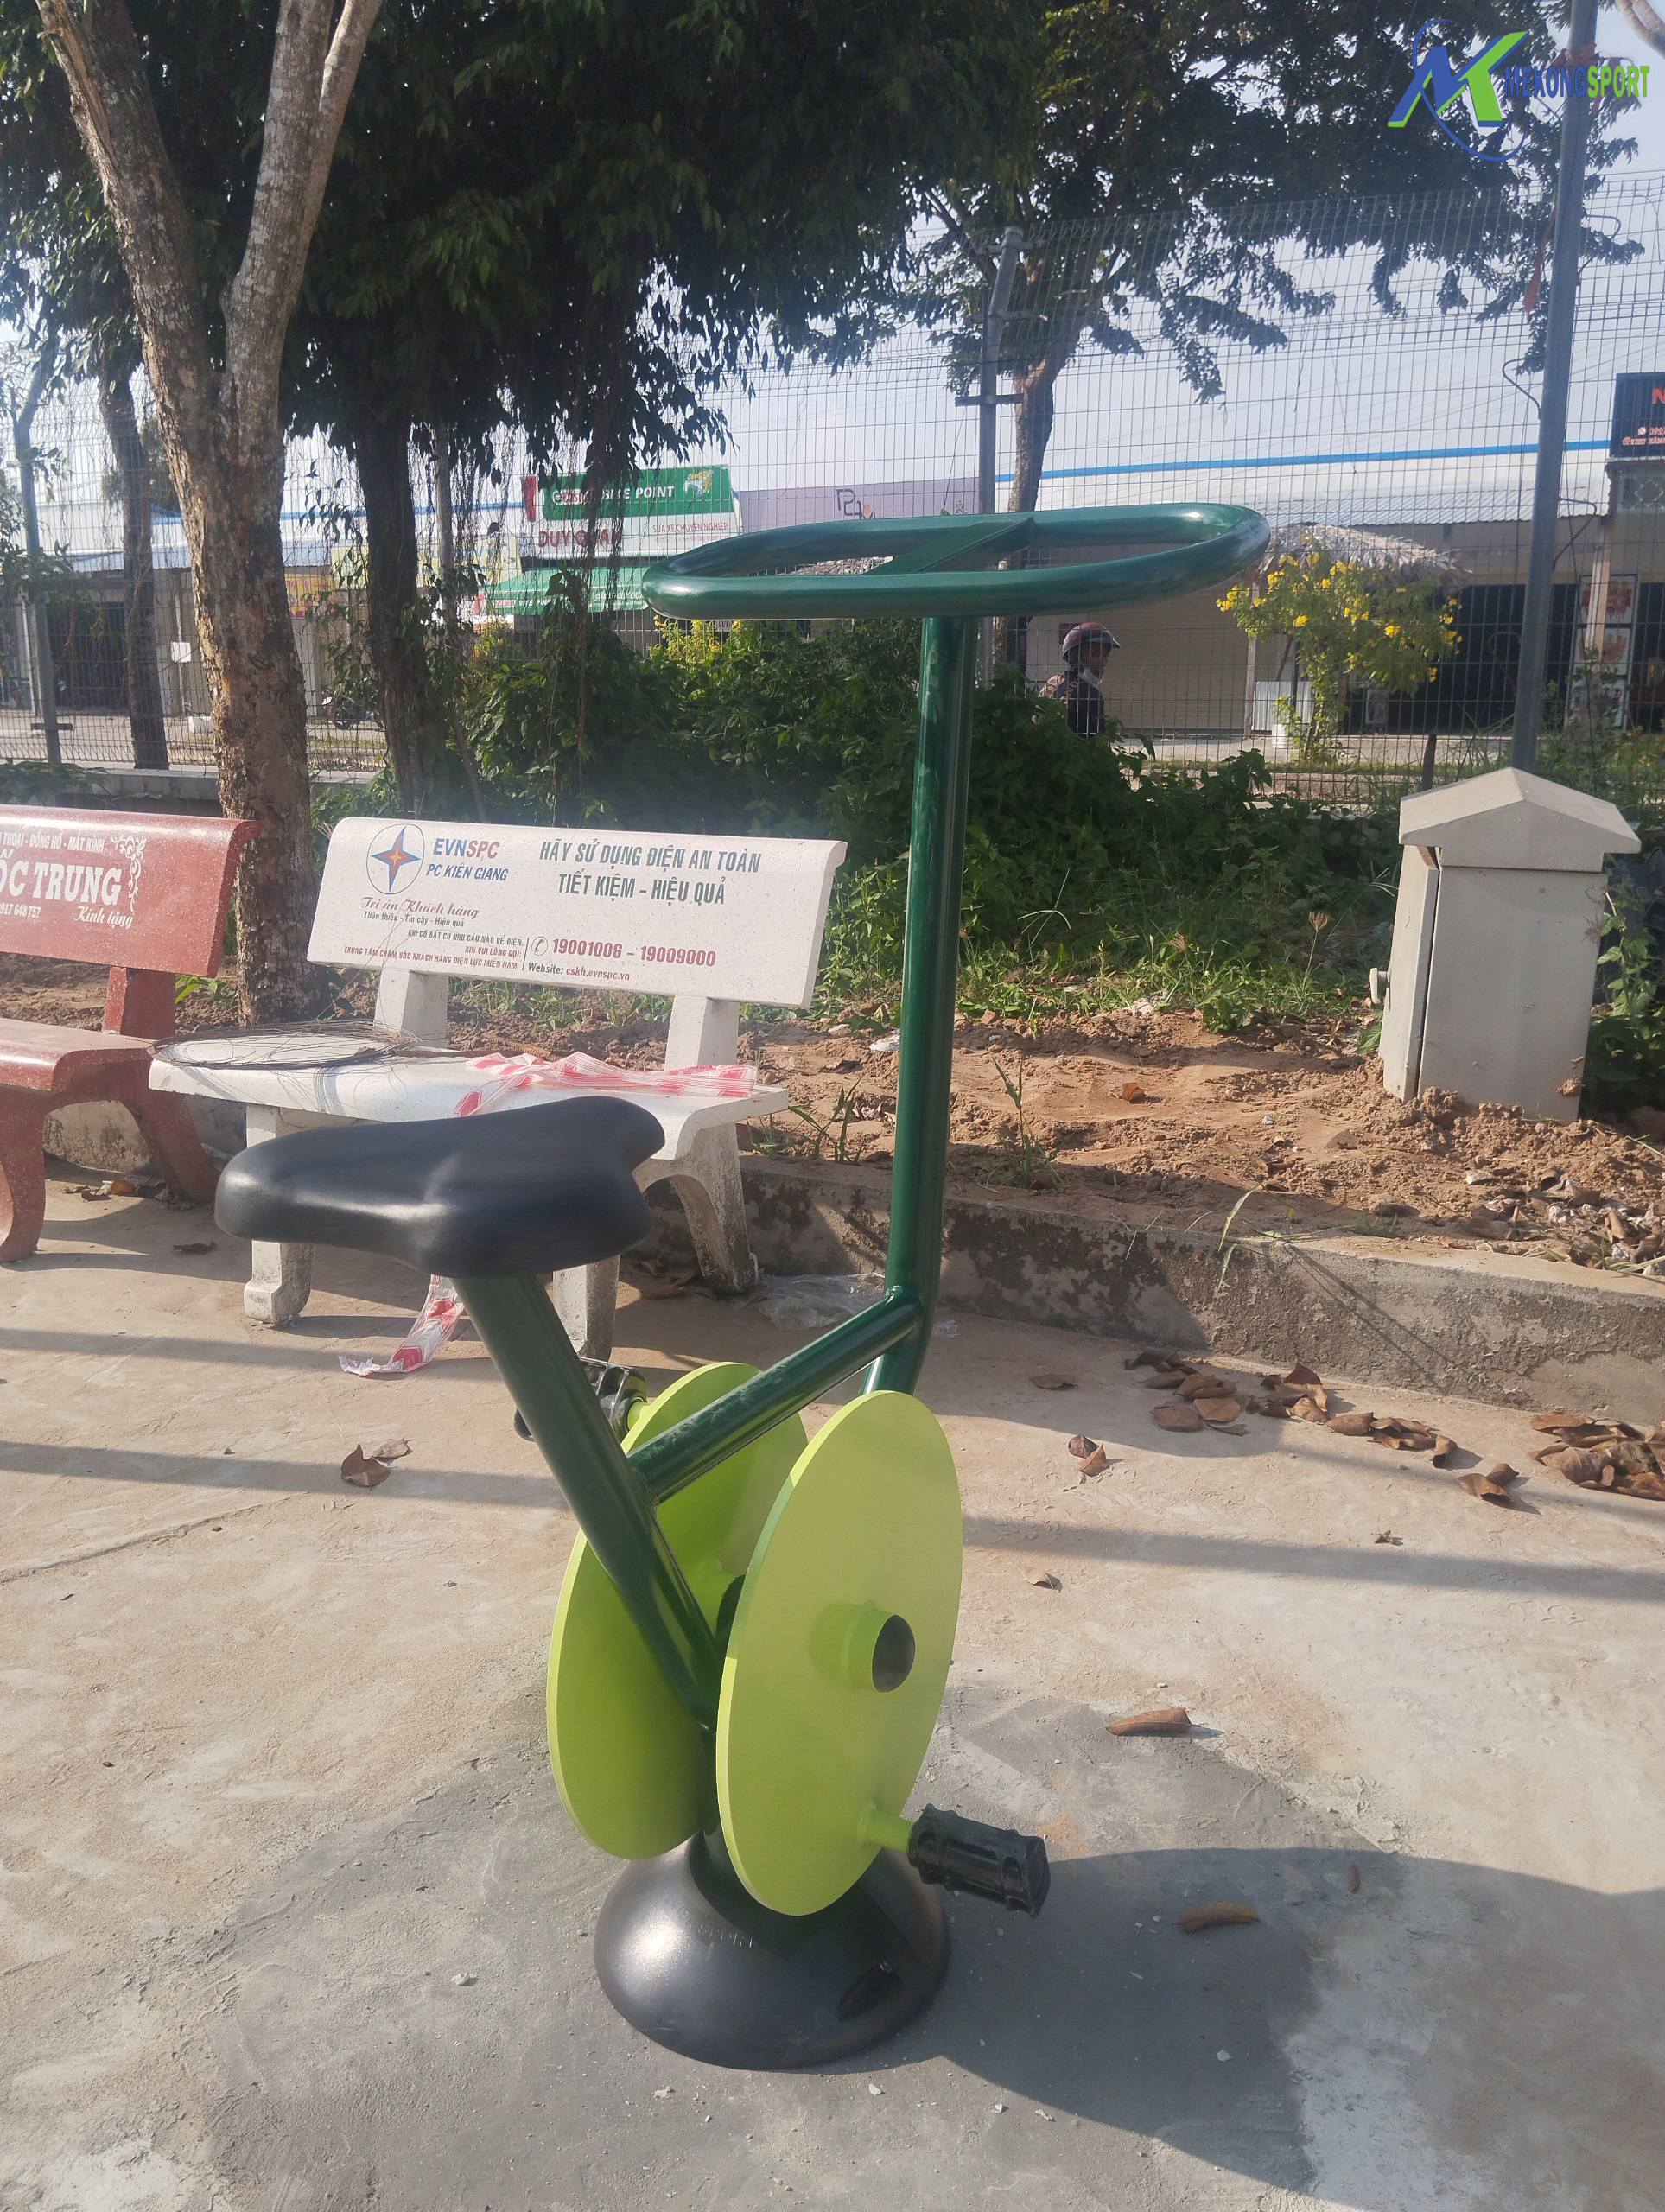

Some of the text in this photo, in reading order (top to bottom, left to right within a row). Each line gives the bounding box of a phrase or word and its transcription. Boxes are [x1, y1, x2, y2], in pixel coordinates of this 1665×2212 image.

[635, 486, 675, 499] POINT
[537, 529, 573, 548] DUY
[3, 832, 25, 849] THOẠI
[29, 829, 51, 849] ĐỒNG
[50, 830, 63, 849] HỒ
[67, 832, 85, 851] MẮT
[86, 835, 105, 853] KÍNH
[432, 837, 500, 859] EVNSPC
[539, 838, 762, 874] HÃY SỬ DỤNG ĐIỆN AN TOÀN
[426, 862, 509, 881] PC KIÊN GIANG
[33, 862, 123, 906] TRUNG
[558, 868, 592, 895] TIẾT
[594, 873, 636, 902] KIỆM
[651, 876, 690, 906] HIỆU
[693, 876, 727, 905] QUẢ
[73, 905, 134, 930] Kính tặng
[361, 896, 479, 919] Tri ân Khách hàng
[364, 911, 379, 920] Thân
[382, 912, 398, 923] thiện
[404, 913, 415, 924] Tin
[416, 916, 428, 925] cậy
[435, 917, 450, 927] Hiệu
[452, 918, 464, 928] quả
[408, 929, 417, 938] KHI
[419, 929, 428, 938] CÓ
[442, 931, 452, 940] CỨ
[453, 932, 466, 942] NHU
[467, 932, 480, 943] CẦU
[480, 934, 494, 944] NÀO
[344, 946, 363, 956] TRUNG
[365, 947, 378, 957] TÂM
[399, 950, 412, 960] SÓC
[412, 952, 434, 962] KHÁCH
[435, 954, 452, 963] HÀNG
[454, 956, 469, 966] ĐIỆN
[470, 957, 483, 968] LỰC
[484, 958, 501, 968] MIỀN
[465, 945, 522, 958] XIN VUI LÒNG GỌI:
[552, 938, 623, 959] 19001006
[640, 945, 717, 967] 19009000
[528, 962, 631, 982] Website: cskh.evnspc.vn
